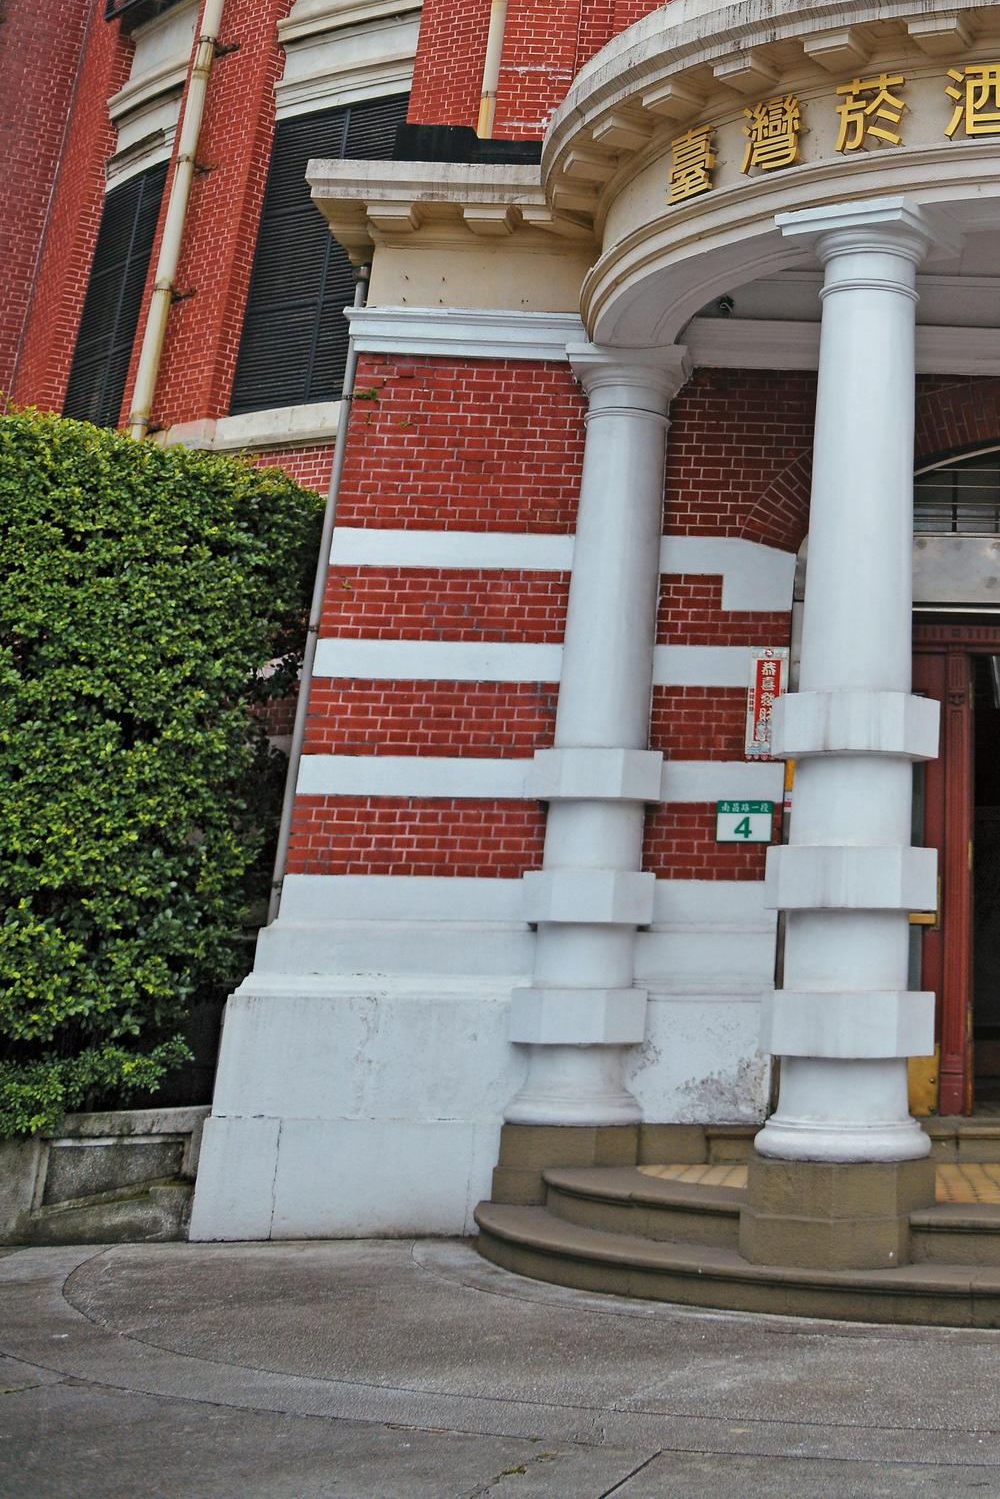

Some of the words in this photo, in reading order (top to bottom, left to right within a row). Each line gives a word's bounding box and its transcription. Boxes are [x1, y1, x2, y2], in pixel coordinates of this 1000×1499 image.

[721, 804, 769, 814] 南昌路一段
[734, 817, 752, 838] 4
